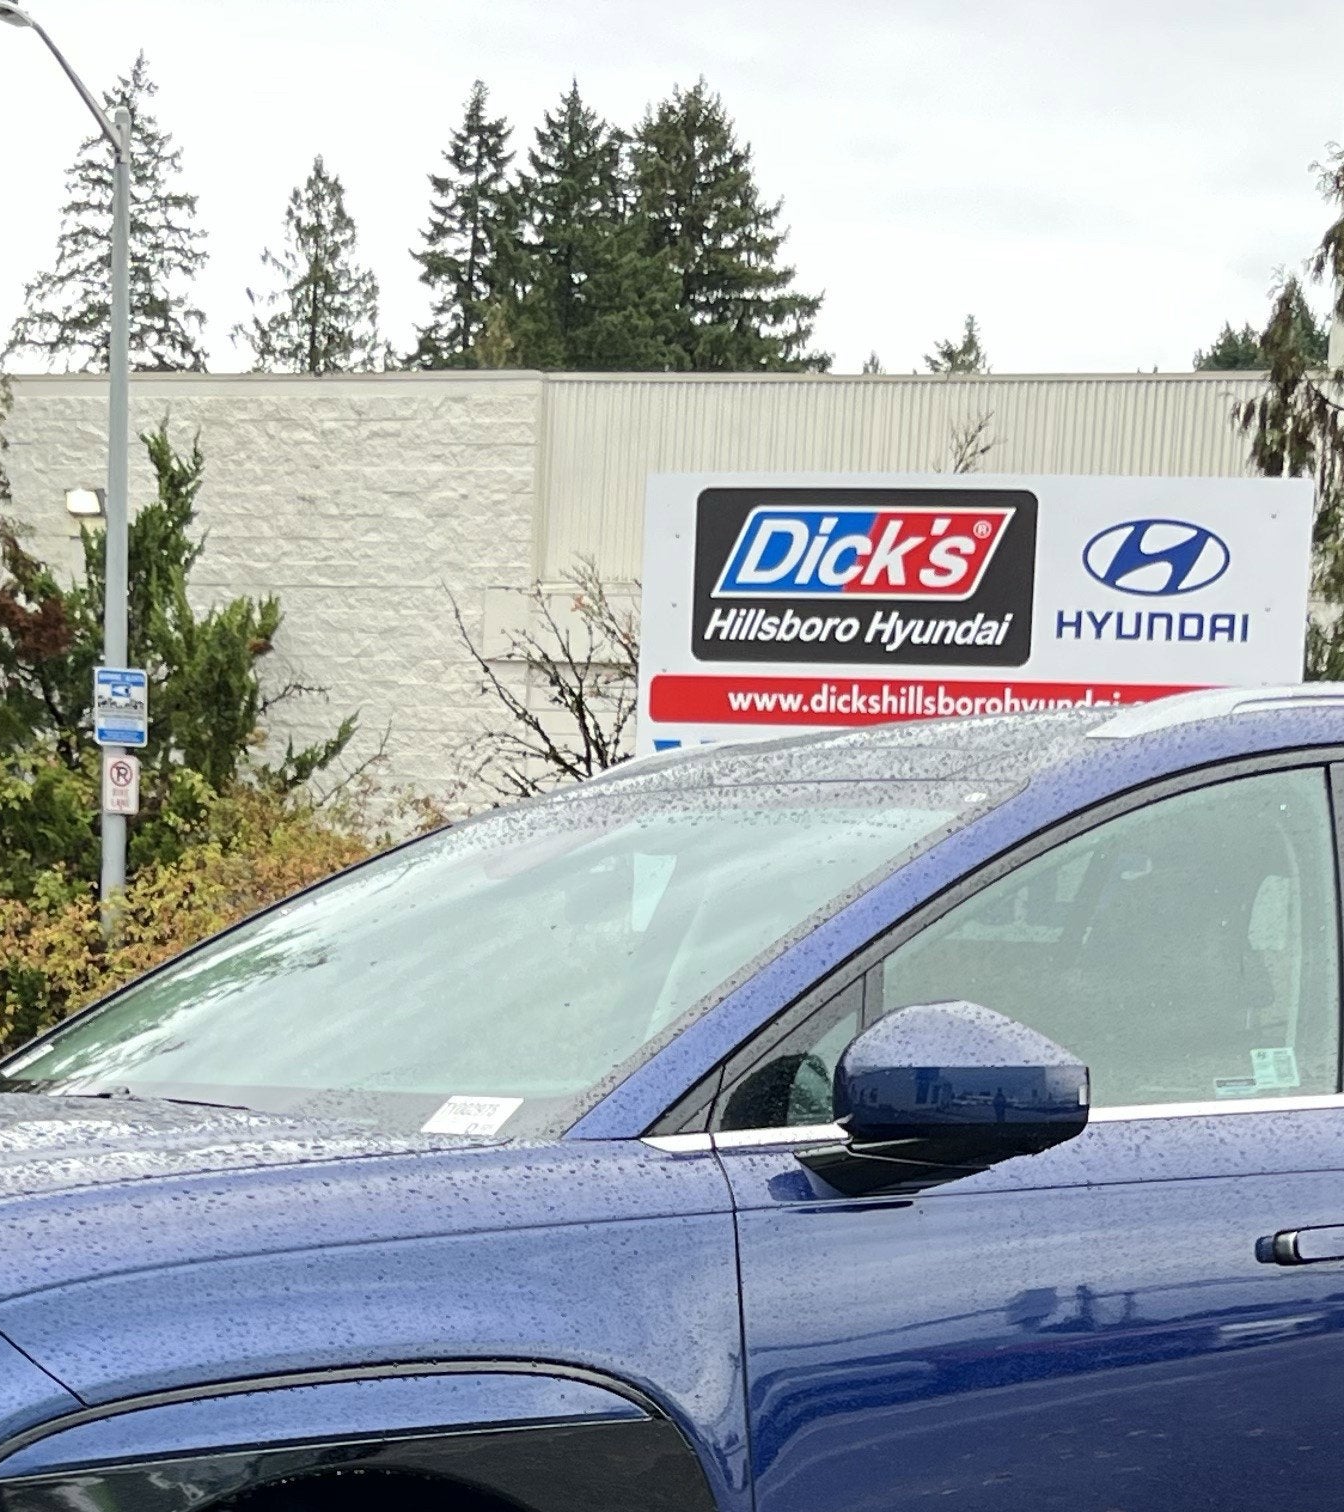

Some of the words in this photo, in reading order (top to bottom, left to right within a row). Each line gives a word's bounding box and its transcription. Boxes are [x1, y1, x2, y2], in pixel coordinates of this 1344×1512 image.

[703, 607, 861, 642] Hillsboro
[864, 610, 1014, 652] Hyundai
[1055, 610, 1250, 643] HYUNDAI
